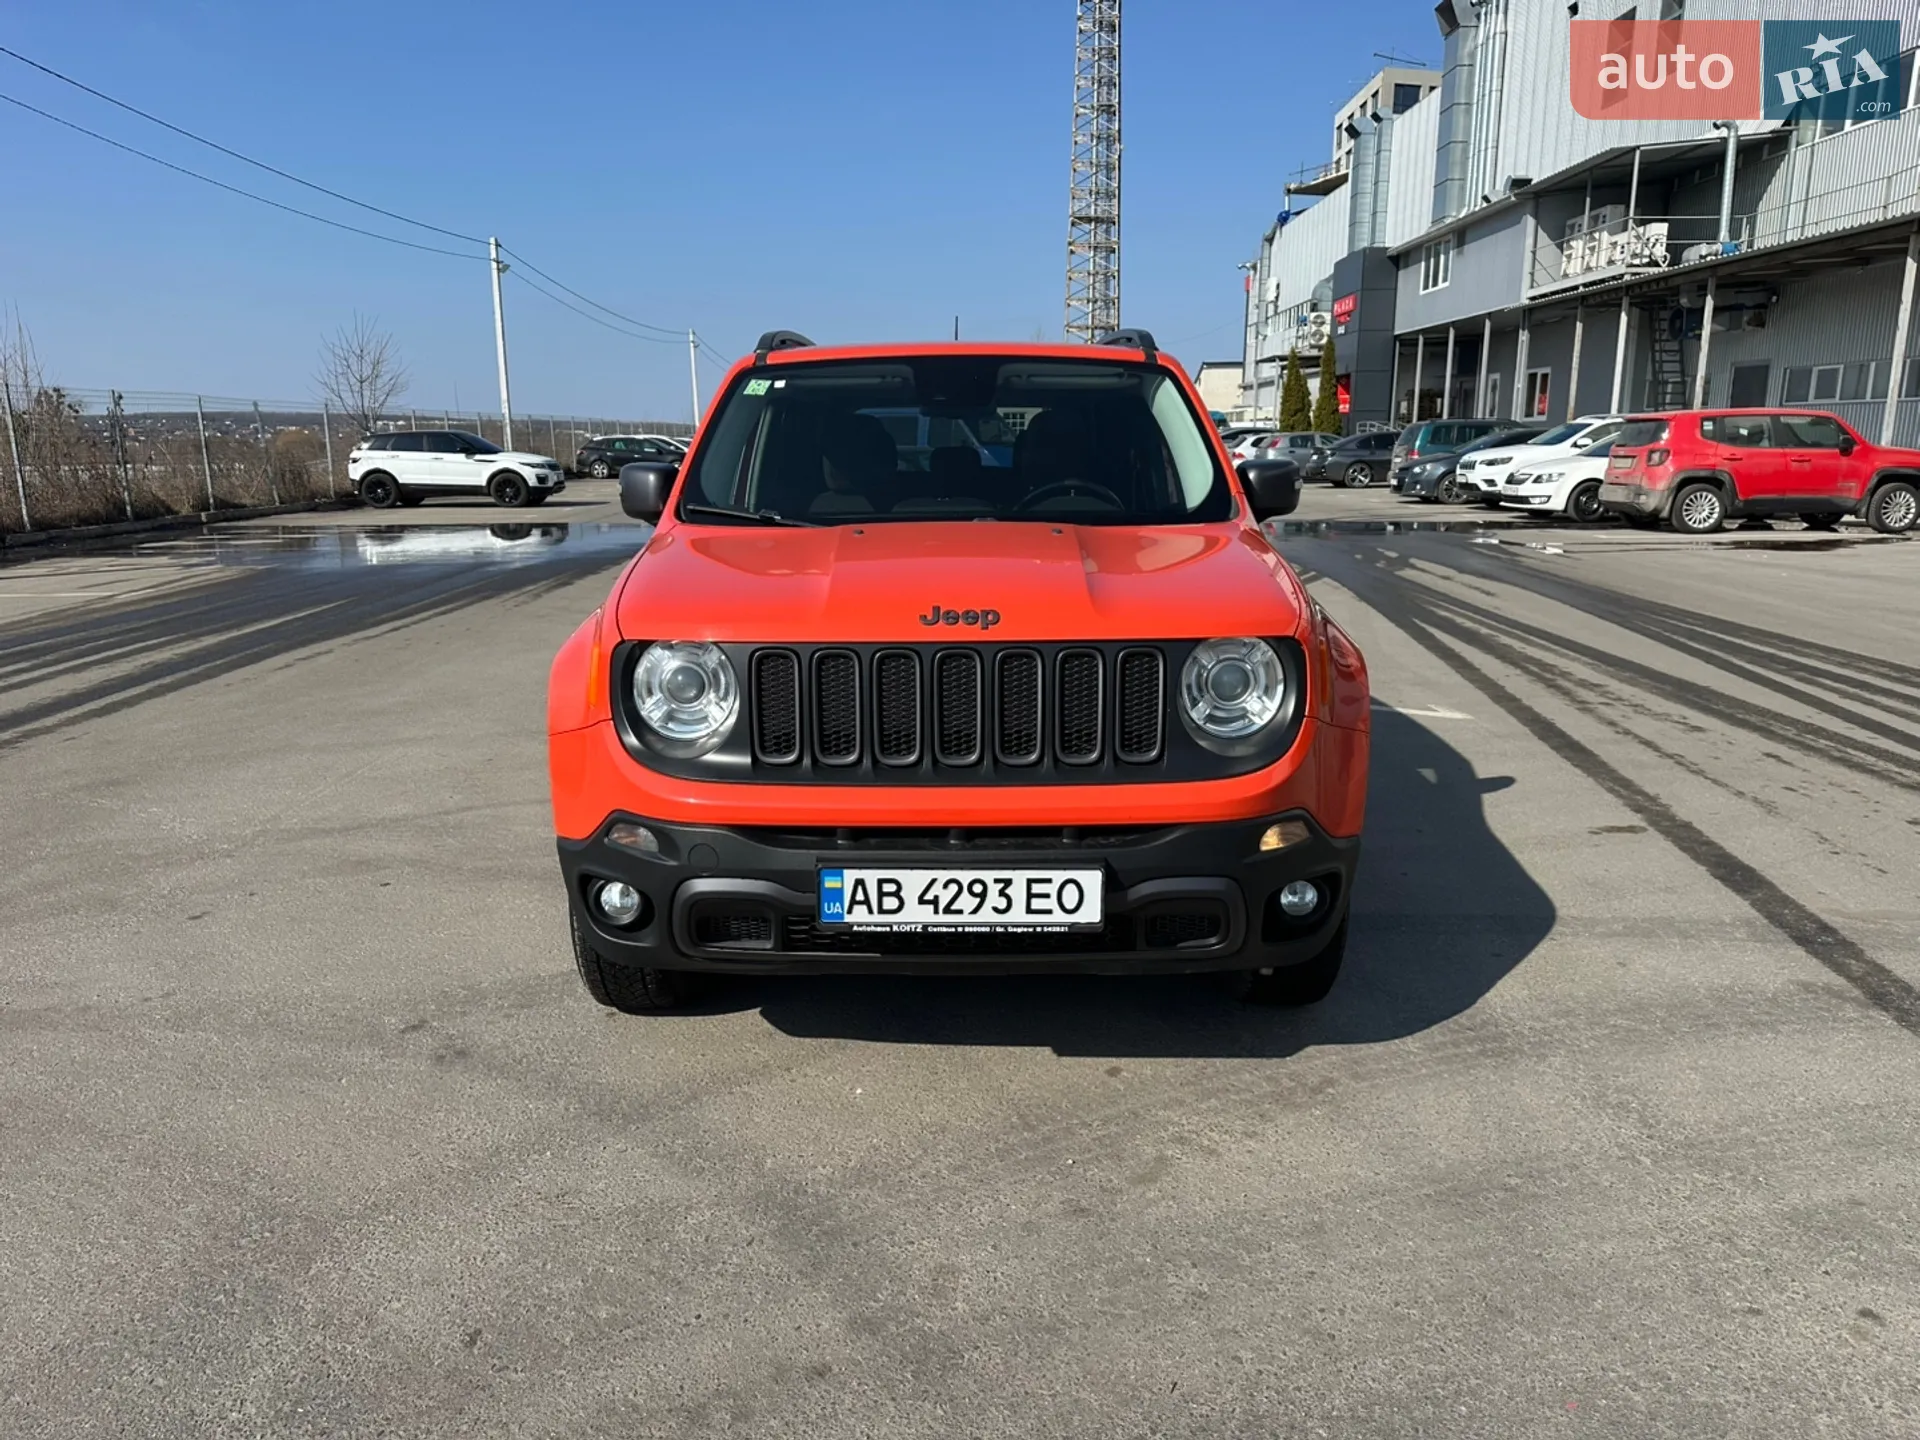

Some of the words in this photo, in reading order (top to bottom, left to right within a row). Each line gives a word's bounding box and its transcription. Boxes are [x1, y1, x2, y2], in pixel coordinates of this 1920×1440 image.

[919, 605, 1000, 630] Jeep
[846, 877, 905, 915] AB
[917, 877, 1013, 915] 4293
[1025, 877, 1085, 915] EO
[824, 902, 843, 914] UA
[892, 924, 923, 932] KOITZ
